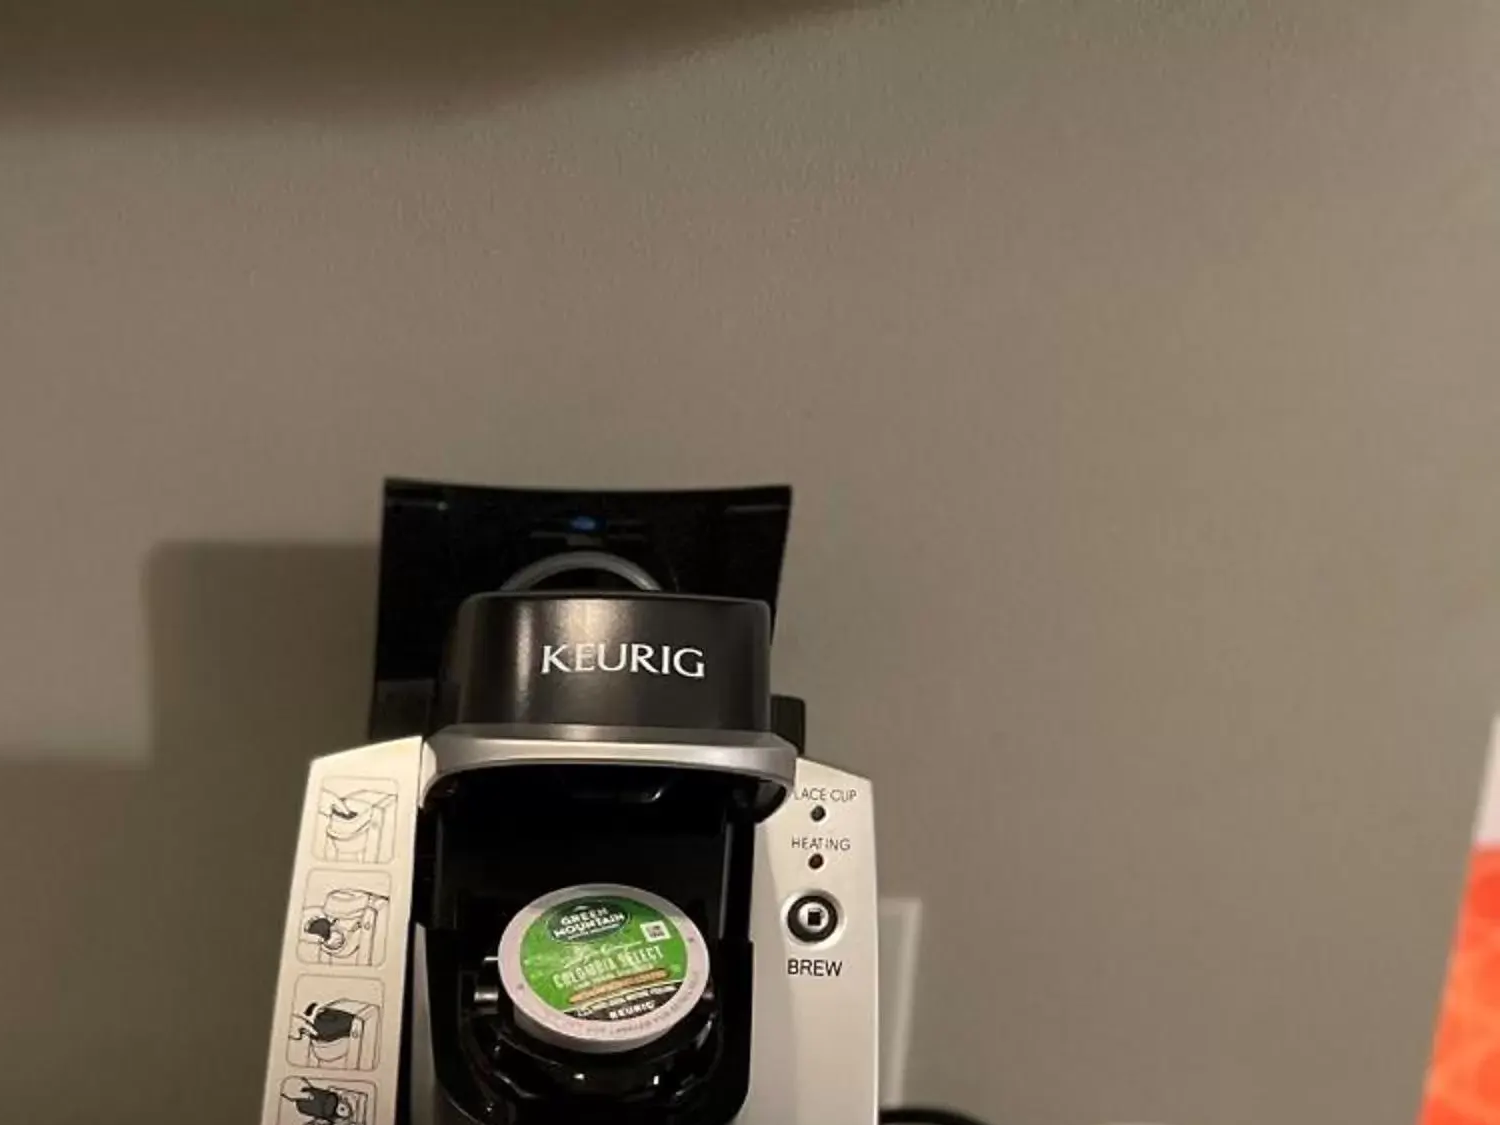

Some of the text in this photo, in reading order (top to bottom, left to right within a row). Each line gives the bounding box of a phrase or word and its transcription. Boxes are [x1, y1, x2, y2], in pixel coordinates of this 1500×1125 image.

[541, 643, 705, 678] KEURIG
[789, 787, 858, 802] LACE CUP
[790, 836, 851, 851] HEATING
[552, 911, 626, 938] MOUNTAIN
[559, 906, 610, 927] GREEN
[617, 944, 664, 968] SELECT
[787, 957, 843, 977] BREW
[608, 999, 656, 1020] KEURIG
